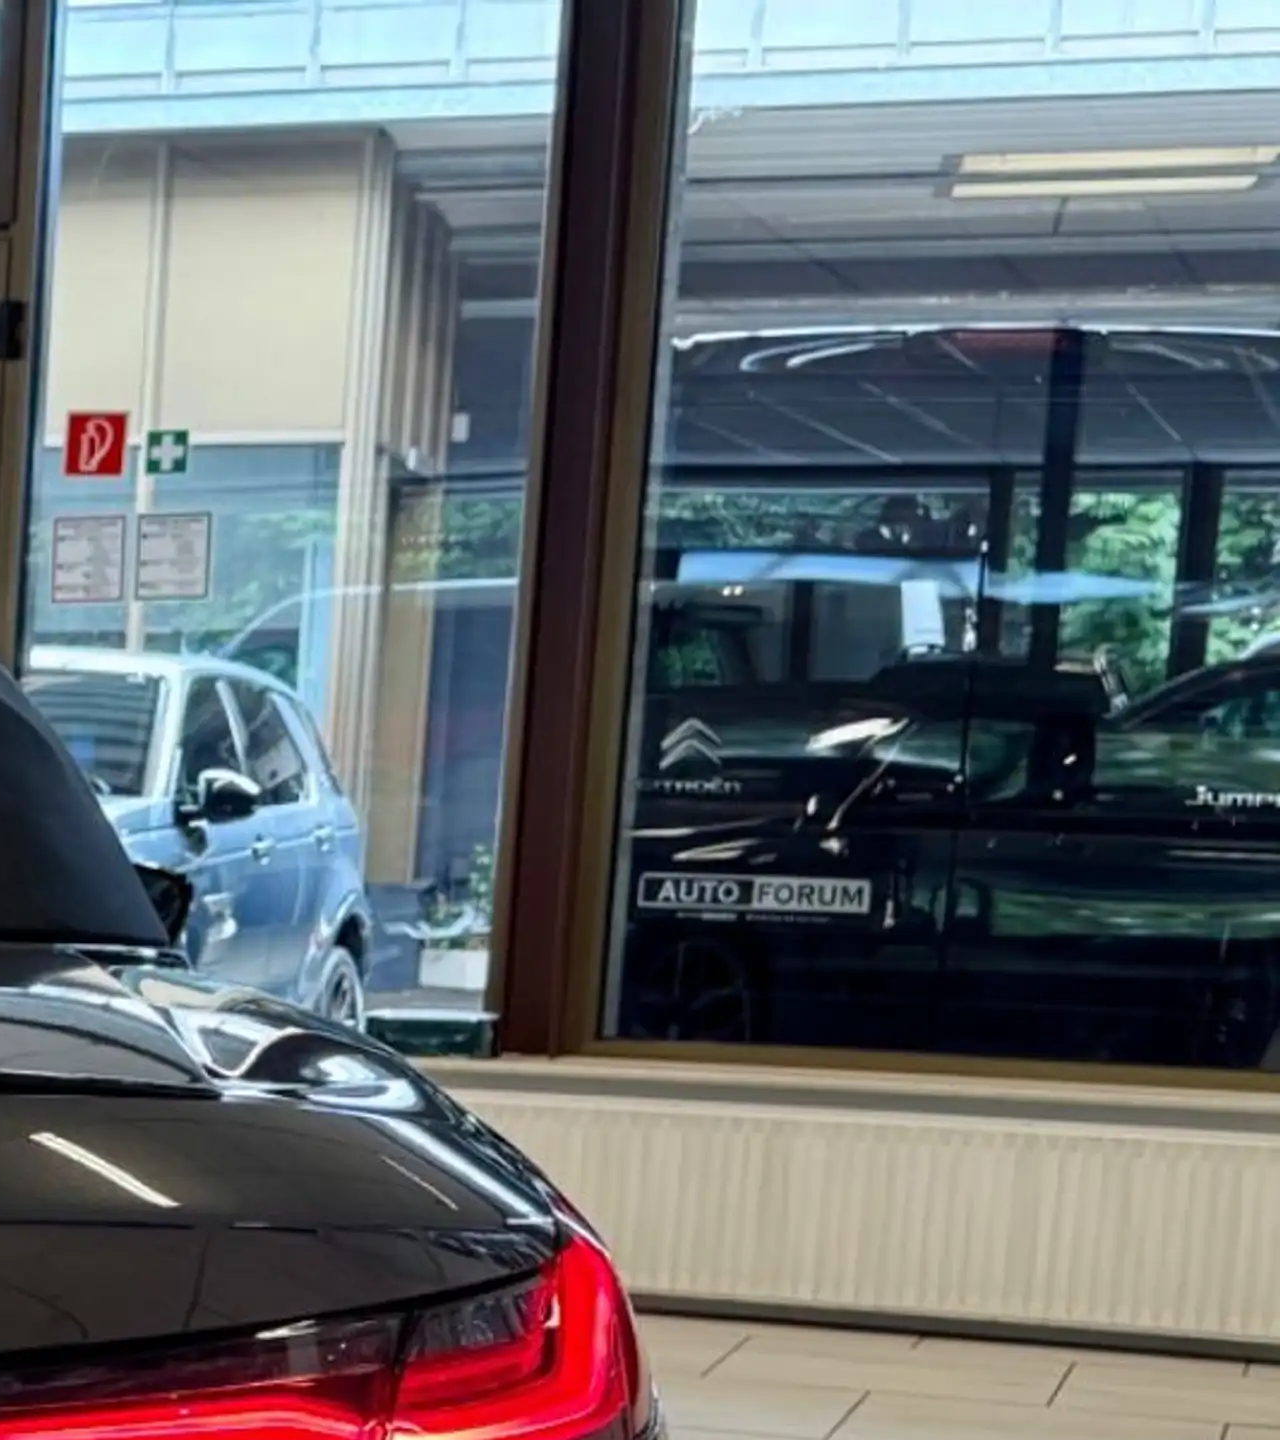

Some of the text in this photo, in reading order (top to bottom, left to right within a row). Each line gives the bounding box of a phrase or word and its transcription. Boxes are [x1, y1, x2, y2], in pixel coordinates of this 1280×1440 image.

[1183, 784, 1280, 808] Jump
[657, 879, 866, 908] AUTO FORUM
